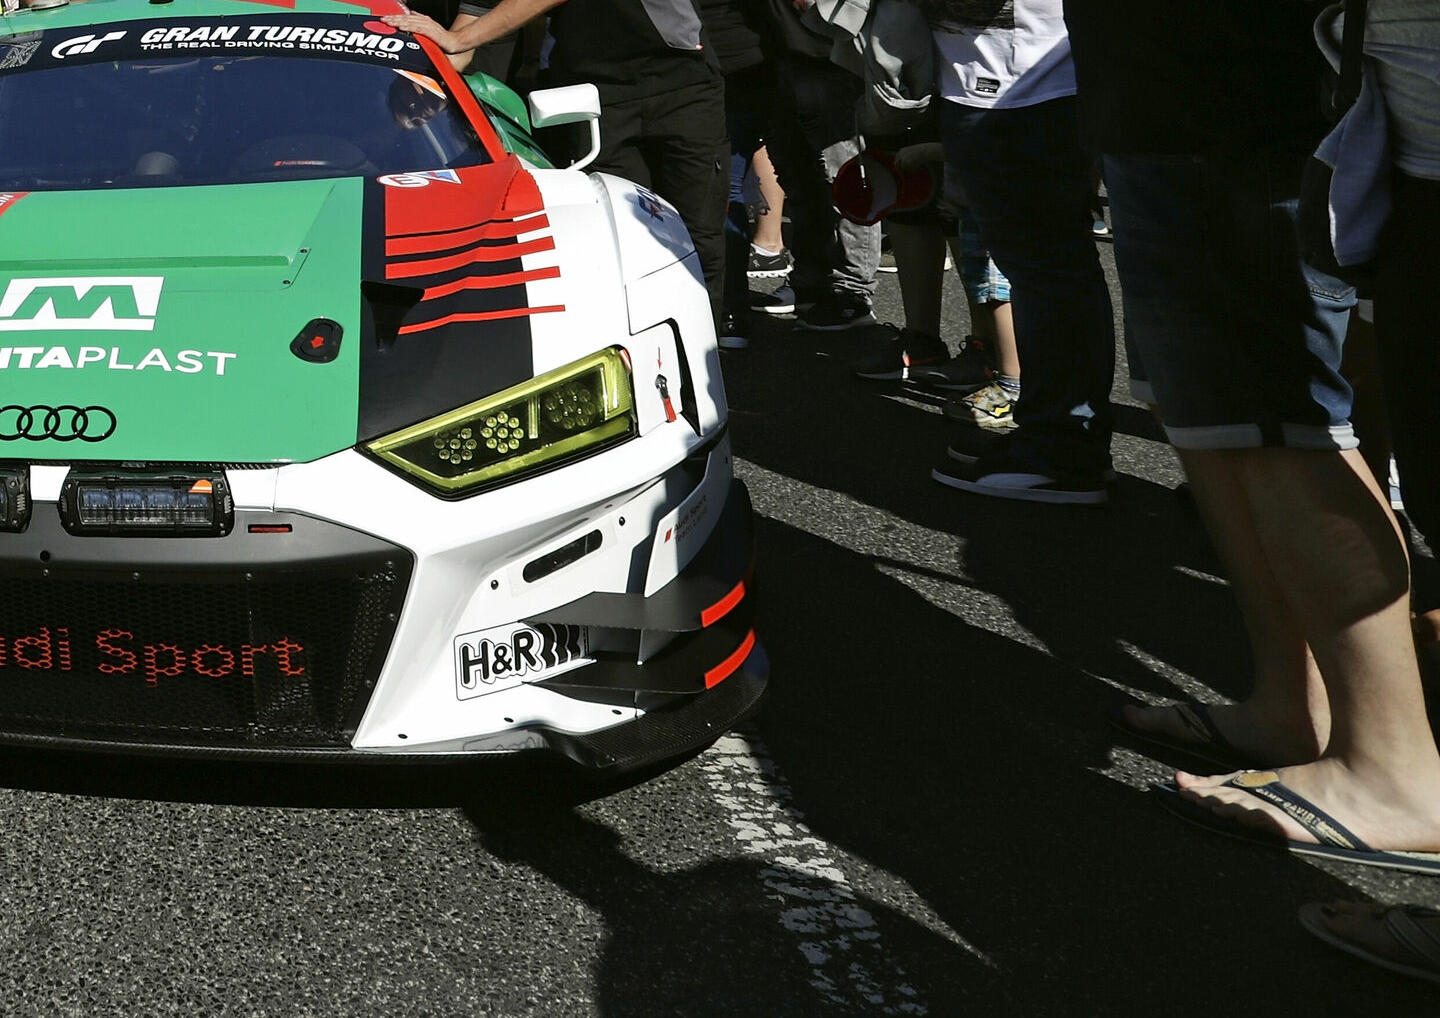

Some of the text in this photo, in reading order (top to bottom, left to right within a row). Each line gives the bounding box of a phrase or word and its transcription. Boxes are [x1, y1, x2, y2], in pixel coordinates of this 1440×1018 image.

[140, 25, 240, 44] GRAN
[141, 43, 172, 51] THE
[224, 41, 295, 49] DRIVING
[299, 42, 400, 61] SIMULATOR
[96, 627, 306, 687] Sport
[461, 630, 537, 685] H&R
